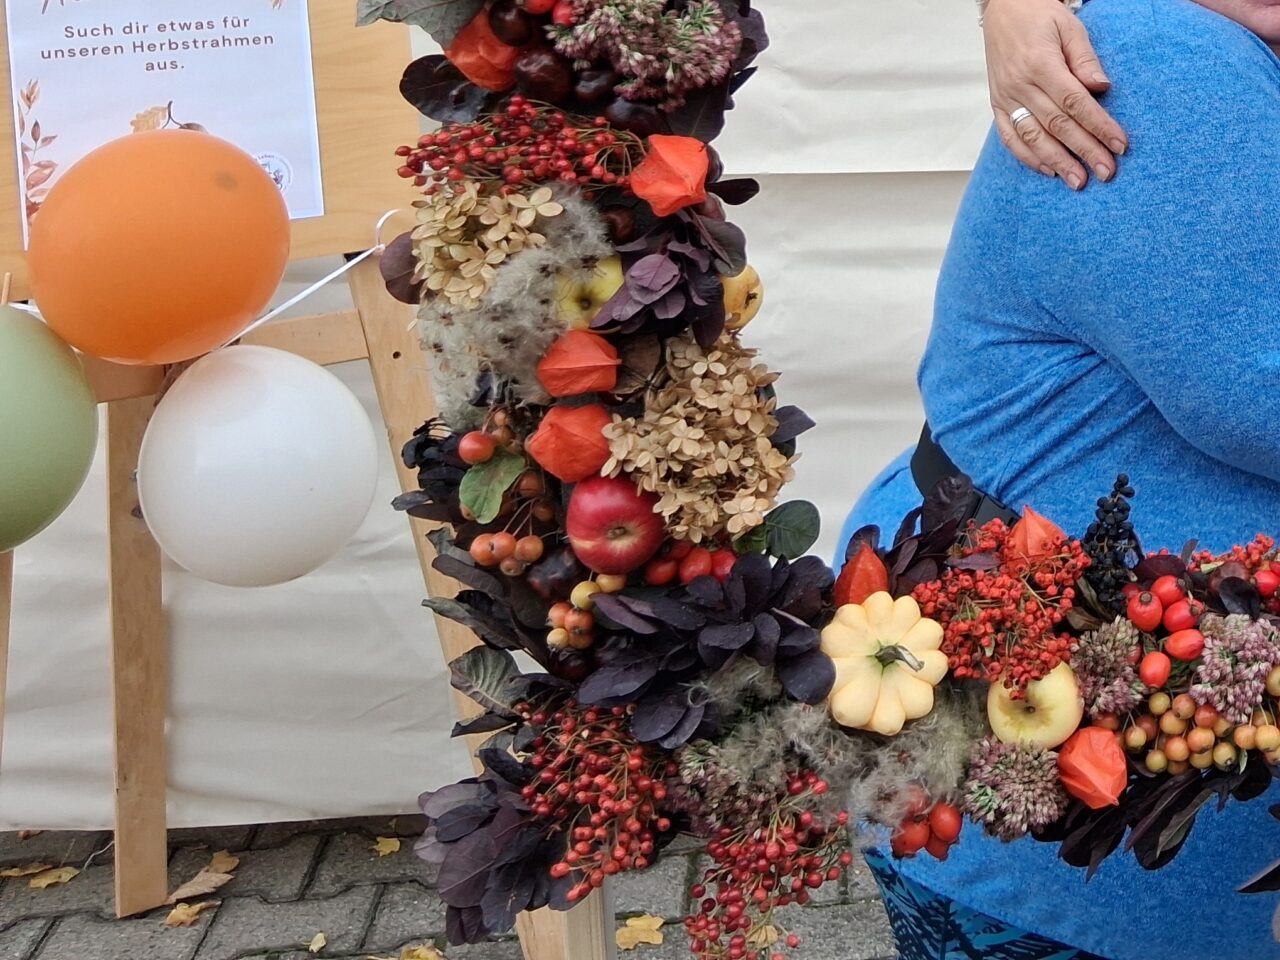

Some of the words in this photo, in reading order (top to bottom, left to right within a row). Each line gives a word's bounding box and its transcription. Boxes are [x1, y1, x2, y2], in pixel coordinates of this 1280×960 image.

[64, 22, 114, 39] Such
[122, 19, 149, 36] dir
[157, 17, 215, 33] etwas
[222, 16, 250, 30] für
[40, 42, 125, 60] unseren
[132, 35, 274, 54] Herbstrahmen
[145, 59, 185, 72] aus.
